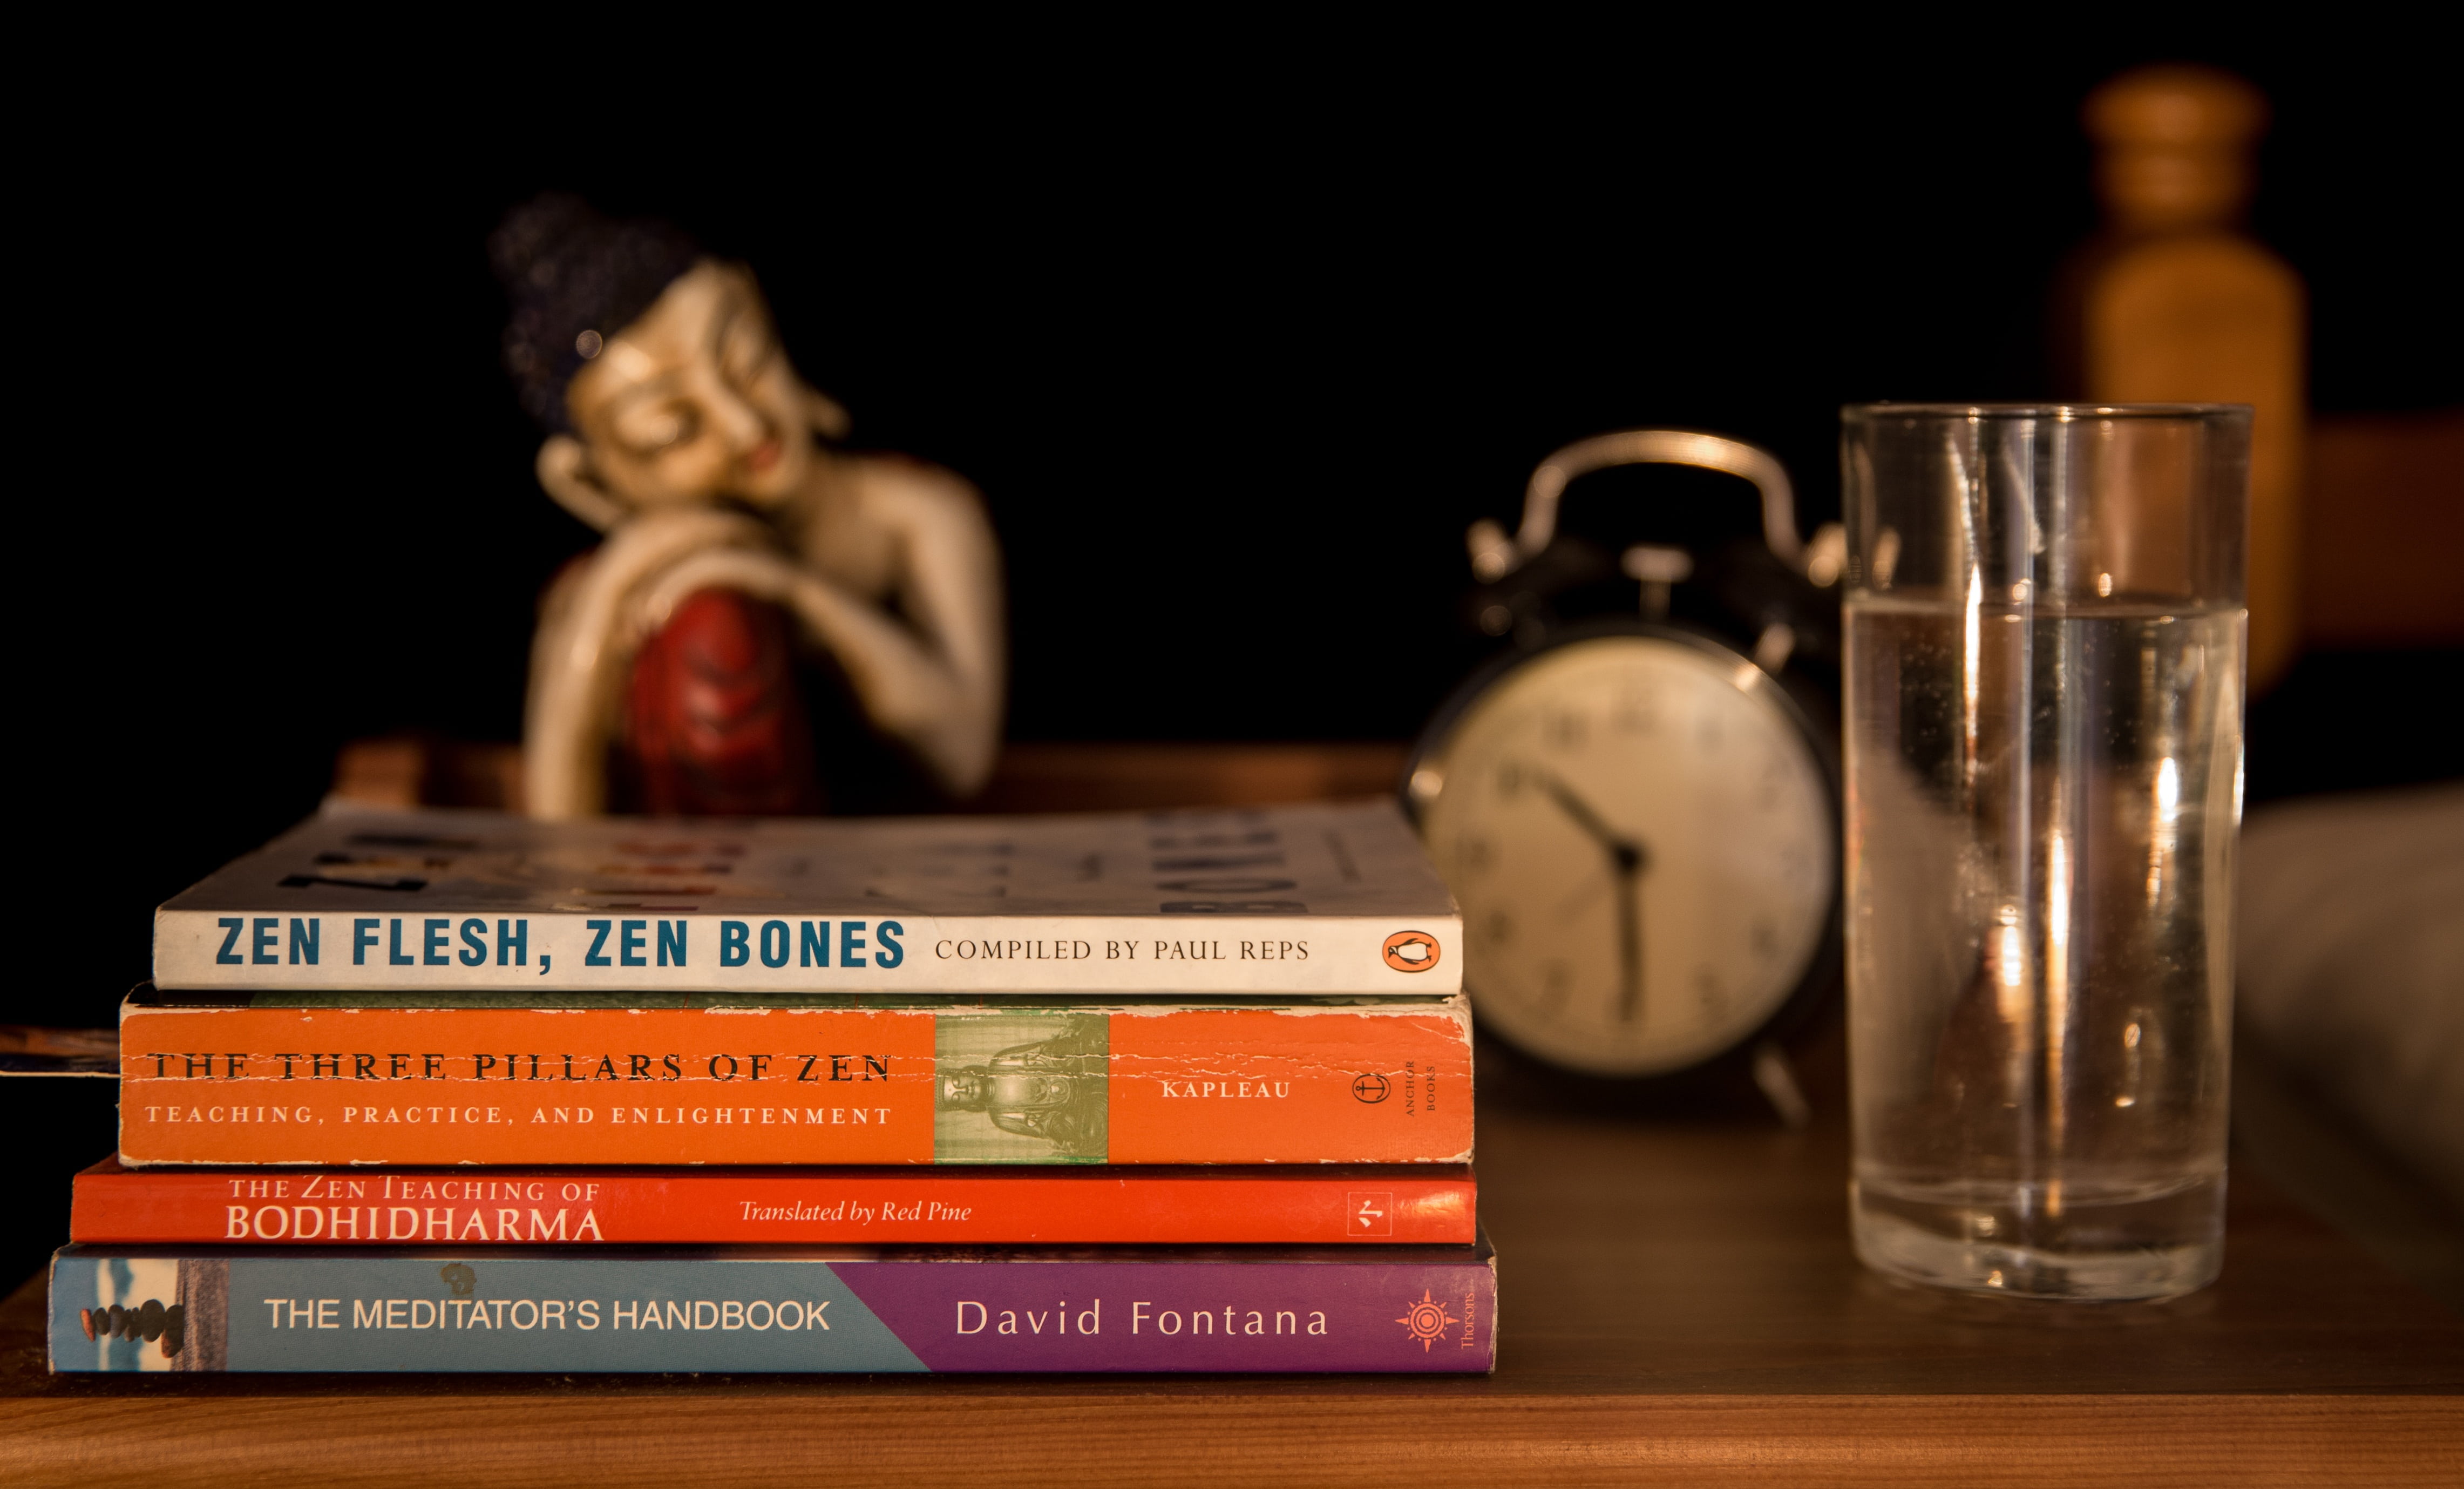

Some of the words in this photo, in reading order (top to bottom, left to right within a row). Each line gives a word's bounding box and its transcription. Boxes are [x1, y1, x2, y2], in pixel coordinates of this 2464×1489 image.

[216, 917, 320, 965] ZEN
[352, 918, 551, 976] FLESH,
[585, 919, 687, 967] ZEN
[720, 921, 904, 969] BONES
[935, 940, 1091, 960] COMPILED
[1107, 941, 1139, 960] BY
[1154, 941, 1226, 960] PAUL
[1240, 941, 1309, 960] REPS
[147, 1053, 249, 1079] THE
[274, 1053, 446, 1080] THREE
[472, 1054, 682, 1081] PILLARS
[709, 1054, 772, 1081] OF
[797, 1054, 892, 1082] ZEN
[1161, 1081, 1290, 1098] KAPLEAU
[1406, 1061, 1415, 1117] ANCHOR
[1427, 1066, 1435, 1111] BOOKS
[145, 1106, 324, 1125] TEACHING,
[343, 1107, 513, 1126] PRACTICE,
[531, 1107, 594, 1123] AND
[611, 1107, 891, 1124] ENLIGHTENMENT
[229, 1179, 289, 1199] THE
[300, 1175, 366, 1199] ZEN
[379, 1175, 544, 1201] TEACHING
[561, 1182, 601, 1202] OF
[225, 1206, 605, 1241] BODHIDHARMA
[740, 1201, 845, 1221] Translated
[849, 1200, 875, 1224] by
[881, 1201, 922, 1221] Red
[927, 1201, 972, 1221] Pine
[264, 1298, 340, 1329] THE
[352, 1299, 600, 1331] MEDITATOR'S
[613, 1300, 831, 1331] HANDBOOK
[956, 1298, 1100, 1335] David
[1132, 1301, 1328, 1336] Fontana
[1461, 1293, 1475, 1349] Thorsons
